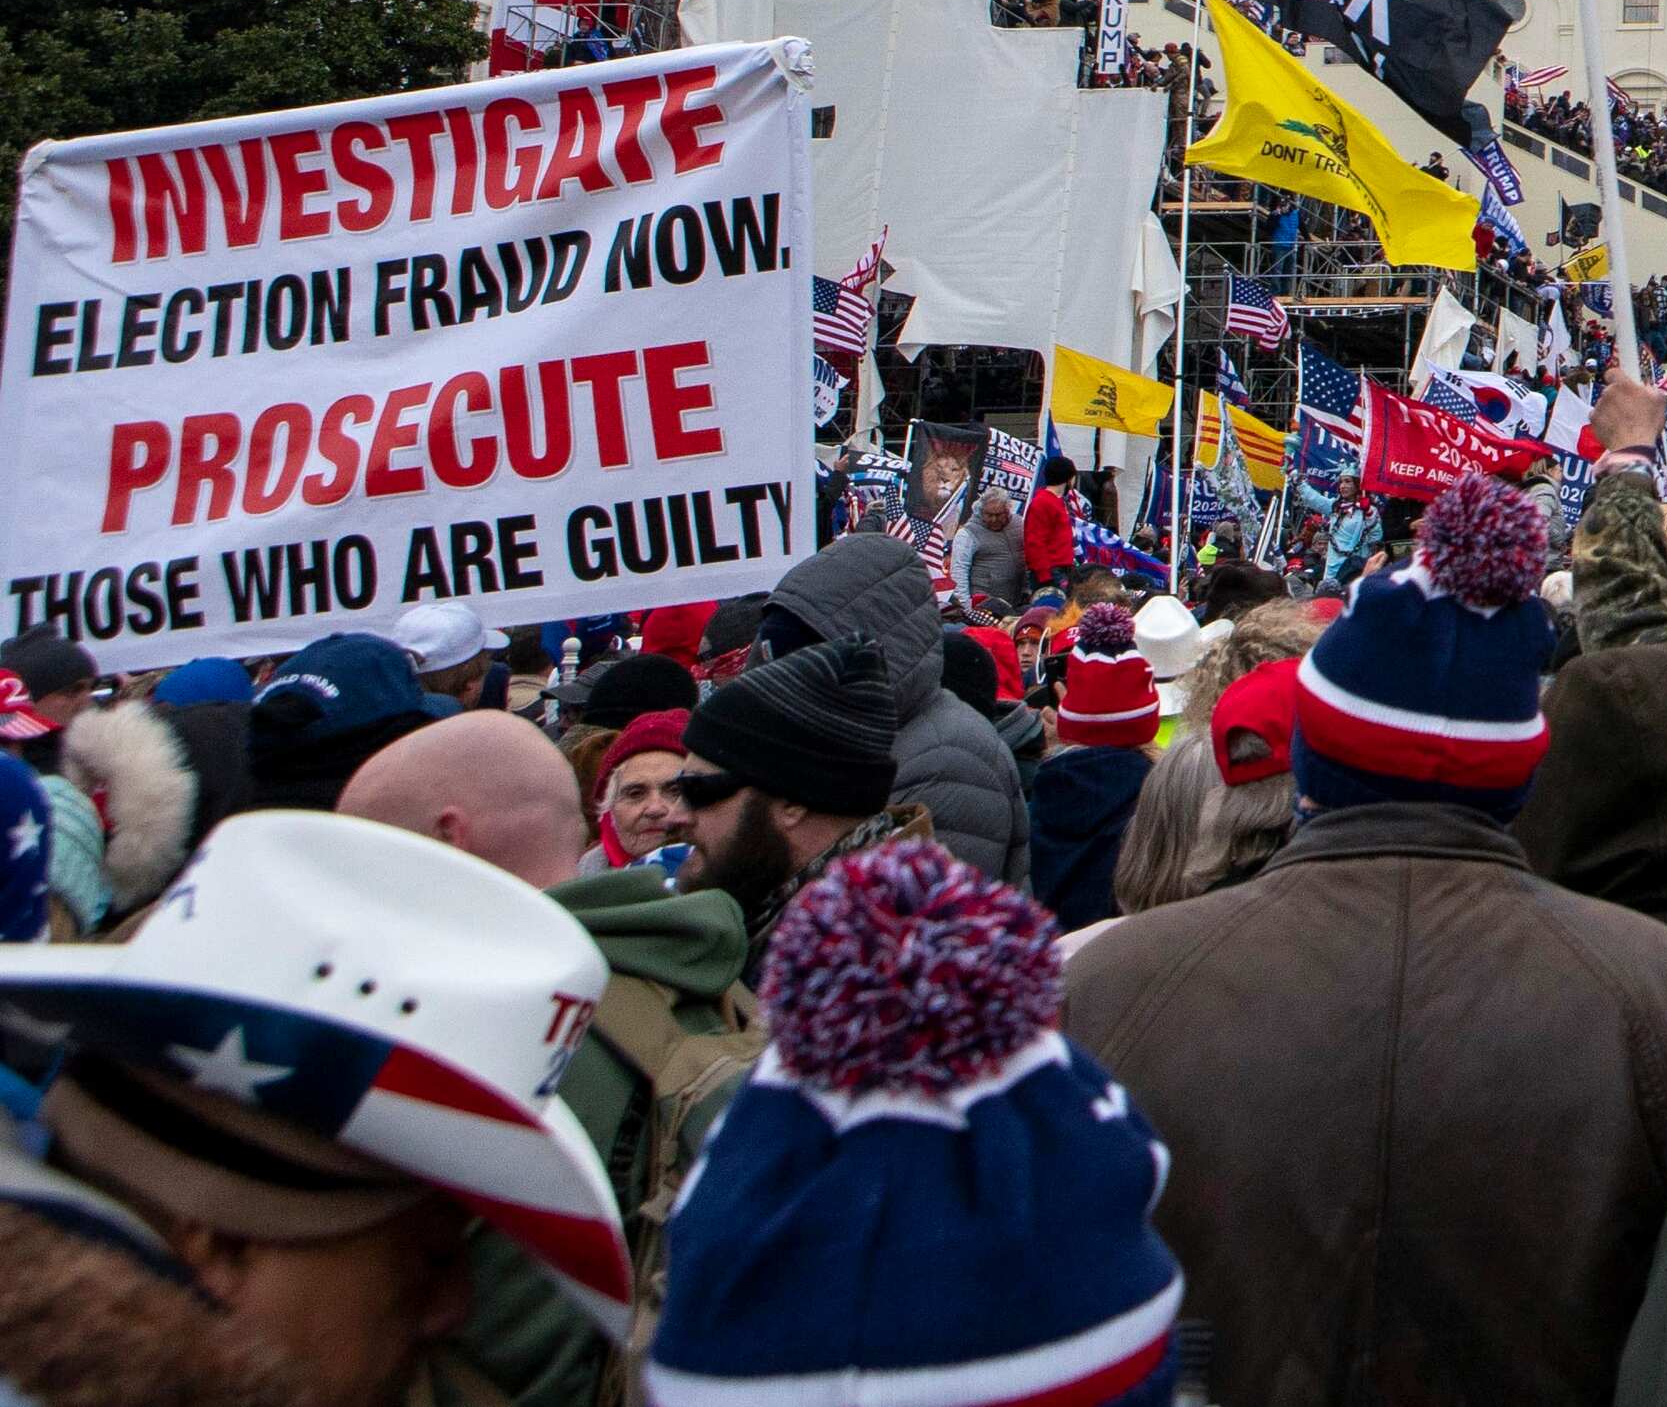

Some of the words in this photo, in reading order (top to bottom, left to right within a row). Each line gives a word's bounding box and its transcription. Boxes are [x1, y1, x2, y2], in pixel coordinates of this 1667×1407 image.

[107, 66, 727, 264] INVESTIGATE
[1313, 150, 1353, 180] TRE
[1484, 140, 1520, 201] TRUMP
[33, 267, 351, 378] ELECTION
[373, 228, 593, 339] FRAUD
[604, 192, 793, 294] NOW.
[102, 339, 724, 534] PROSECUTE
[989, 427, 1047, 465] JESUS
[1390, 392, 1506, 463] TRUM
[1389, 461, 1425, 479] KEEP
[9, 557, 206, 643] THOSE
[223, 532, 379, 624] WHO
[402, 512, 545, 604] ARE
[567, 481, 794, 582] GUILTY
